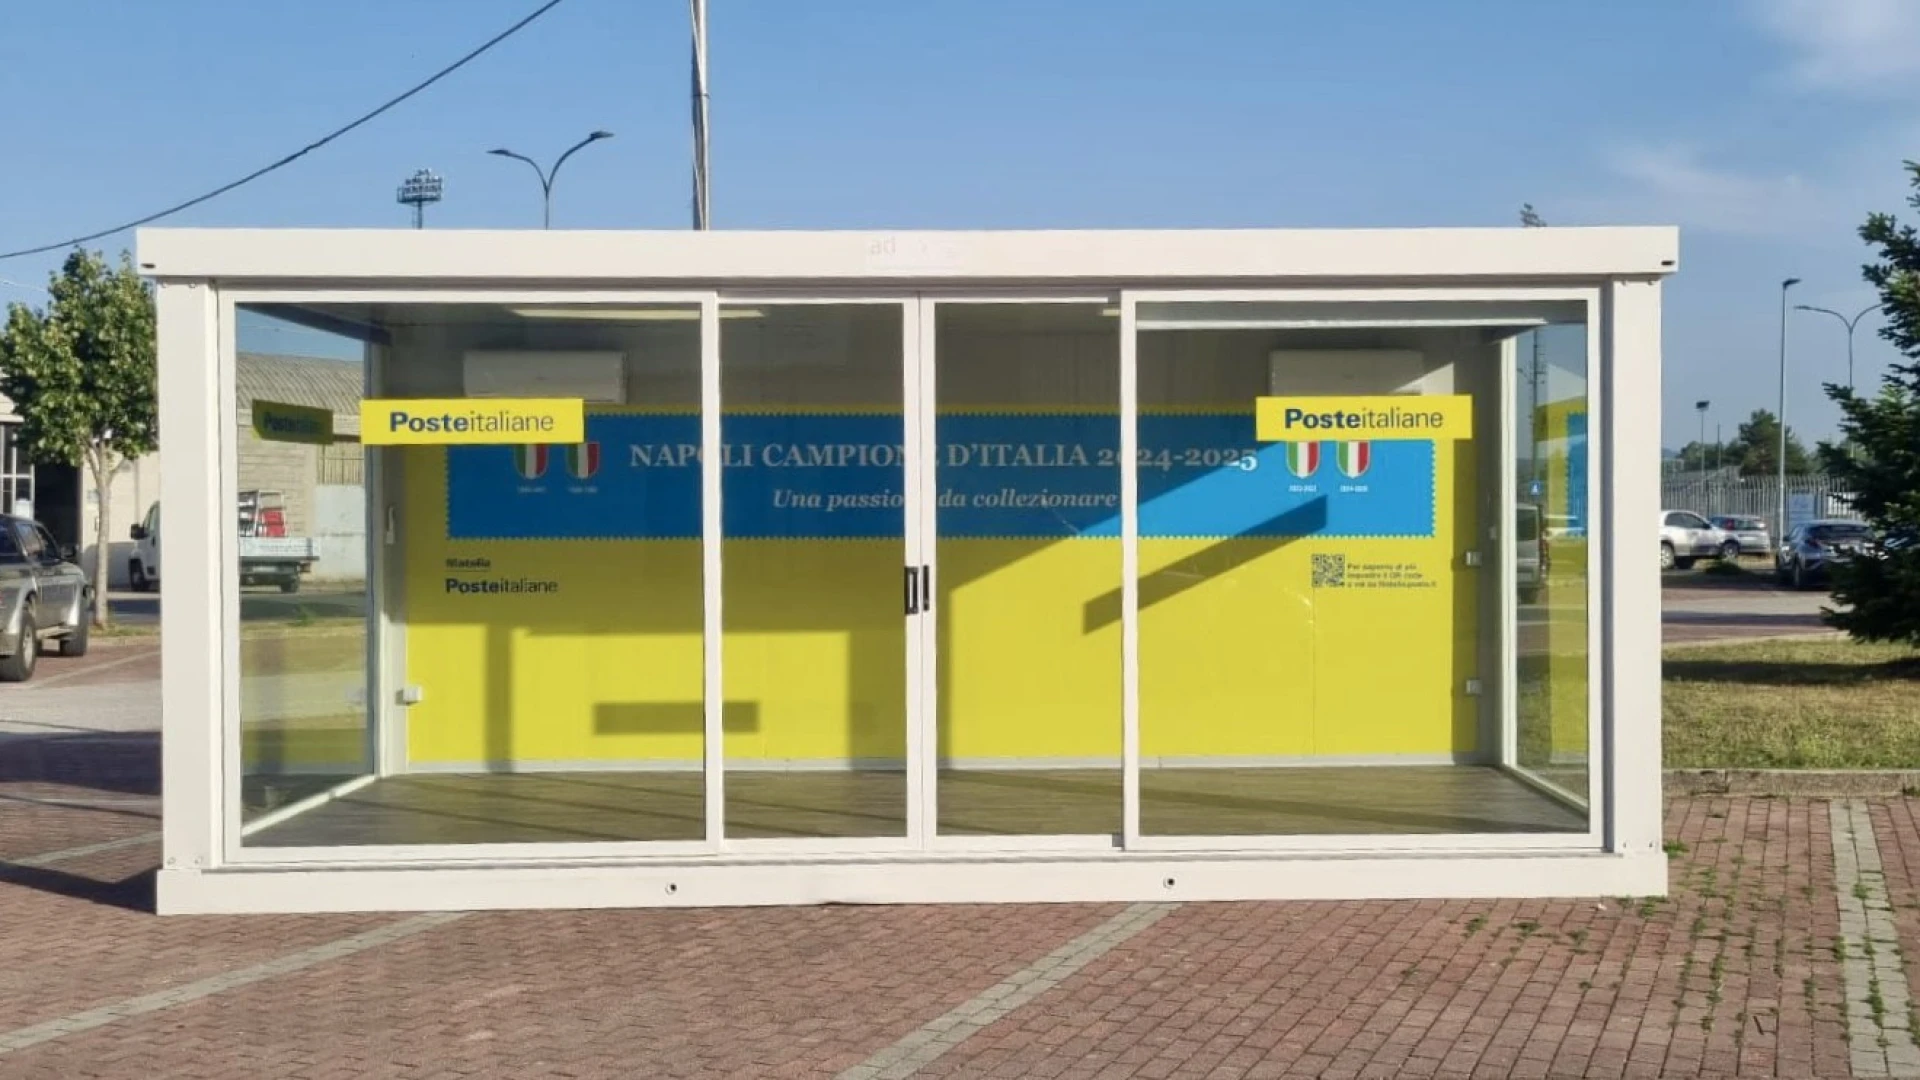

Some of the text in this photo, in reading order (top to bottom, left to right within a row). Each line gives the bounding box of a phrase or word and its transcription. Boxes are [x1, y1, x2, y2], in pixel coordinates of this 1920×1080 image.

[389, 410, 554, 433] Posteitaliane
[1284, 407, 1444, 429] Posteitaliane
[947, 443, 1088, 467] D'ITALIA
[1097, 448, 1258, 472] 224-2025
[772, 488, 1118, 512] Una passio da collezionare
[445, 577, 559, 594] Posteitaliane
